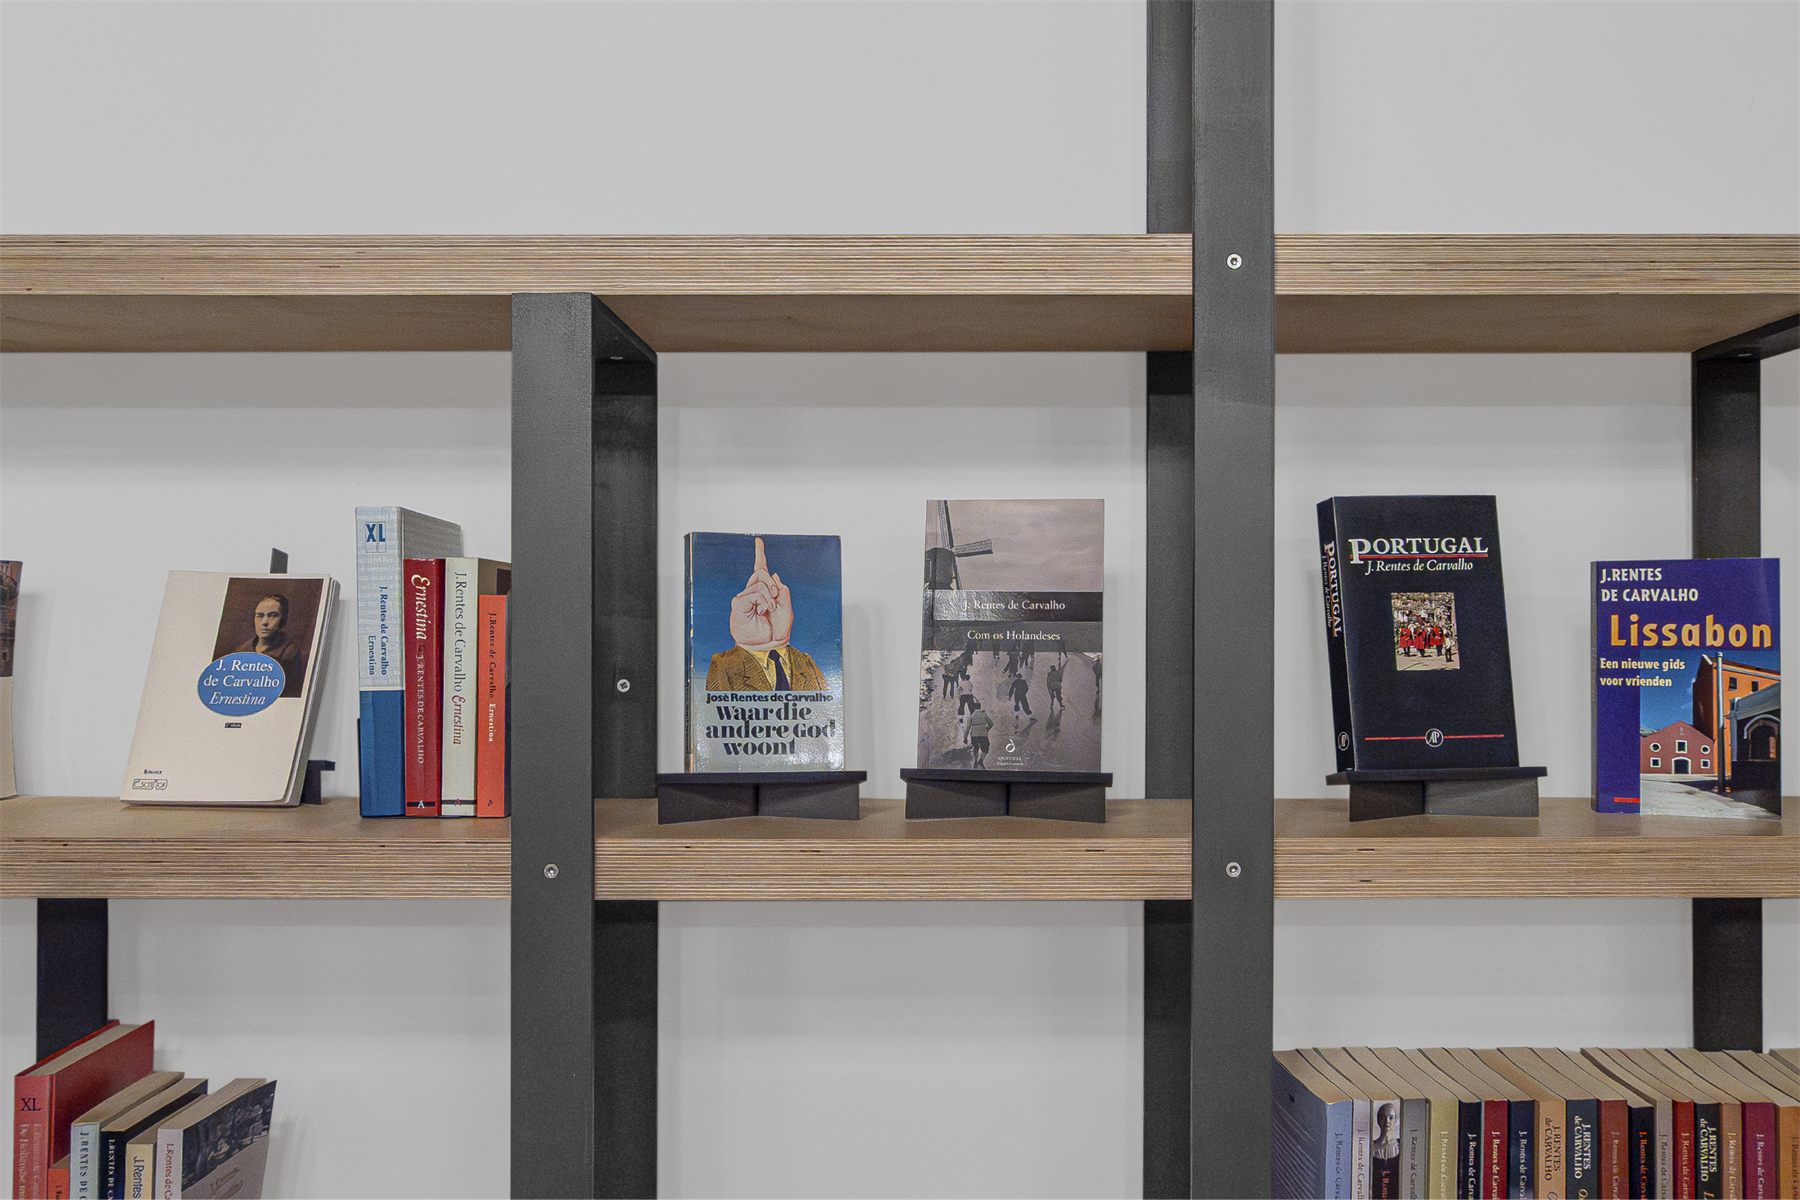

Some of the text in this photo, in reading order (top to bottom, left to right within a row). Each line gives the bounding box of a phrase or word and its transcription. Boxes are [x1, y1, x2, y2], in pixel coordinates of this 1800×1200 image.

[366, 524, 385, 542] XL
[1348, 537, 1489, 564] PORTUGAL
[1365, 558, 1474, 575] J. Rentes de Carvalho
[455, 581, 467, 619] Rentes
[1601, 588, 1699, 602] DE CARVALHO
[379, 594, 389, 622] Rentes
[411, 574, 431, 640] Ernestina
[974, 601, 1005, 610] Rentes
[1008, 600, 1019, 610] de
[1021, 600, 1066, 610] Carvalho
[380, 624, 389, 634] de
[454, 622, 467, 636] de
[967, 630, 990, 640] Com
[1006, 630, 1061, 640] Holandeses
[1610, 614, 1772, 648] Lissabon
[368, 635, 376, 675] Ernestina
[380, 636, 389, 675] Carvalho
[488, 649, 497, 658] de
[216, 660, 273, 672] J. Rentes
[454, 639, 467, 692] Carvalho
[1600, 658, 1685, 672] Een nieuwe gids
[203, 675, 280, 688] de Carvalho
[488, 661, 497, 699] Carvalho
[1600, 676, 1672, 687] voor vrienden
[209, 692, 266, 705] Ernestina
[731, 693, 769, 702] Rentes
[770, 693, 784, 702] de
[785, 693, 833, 702] Carvalho
[452, 695, 466, 745] Ernestina
[489, 703, 497, 742] Ernestina
[706, 719, 836, 738] andere God
[723, 737, 796, 755] woont
[20, 1098, 42, 1111] XL
[1574, 1115, 1583, 1125] de
[1700, 1118, 1708, 1128] de
[1469, 1141, 1477, 1165] Rentes
[1492, 1139, 1500, 1163] Rentes
[1519, 1139, 1527, 1163] Rentes
[1545, 1117, 1553, 1181] de CARVALHO
[1553, 1134, 1561, 1171] RENTES
[1574, 1126, 1583, 1179] CARVALHO
[1583, 1131, 1591, 1170] RENTES
[1700, 1129, 1709, 1182] CARVALHO
[1709, 1135, 1717, 1173] RENTES
[1469, 1167, 1476, 1176] de
[1492, 1164, 1500, 1174] de
[1520, 1164, 1527, 1174] de
[79, 1180, 88, 1193] DE
